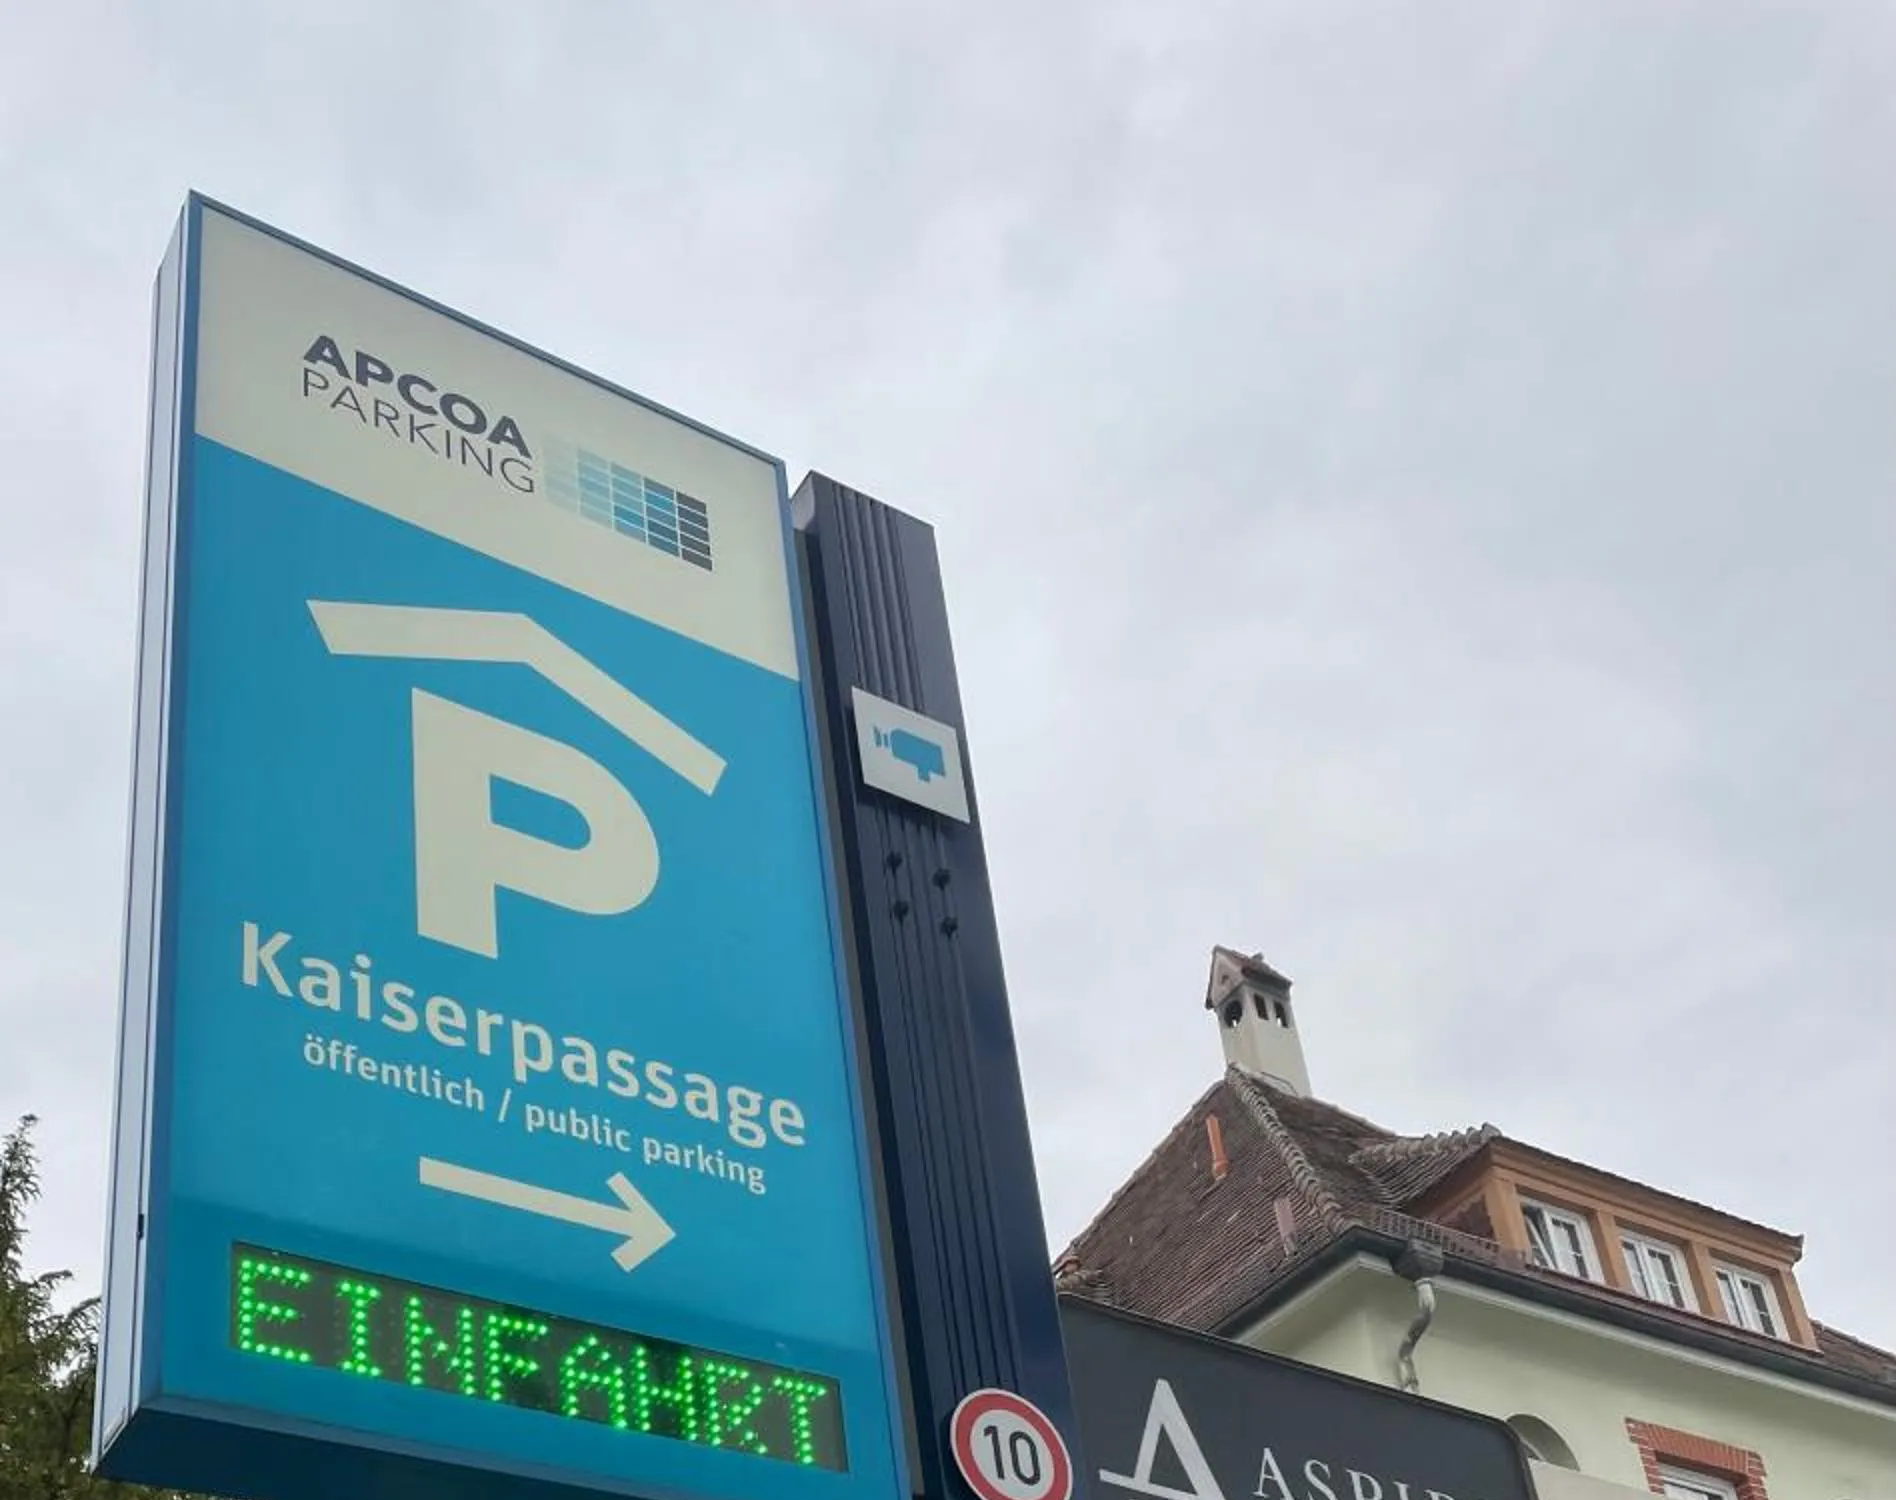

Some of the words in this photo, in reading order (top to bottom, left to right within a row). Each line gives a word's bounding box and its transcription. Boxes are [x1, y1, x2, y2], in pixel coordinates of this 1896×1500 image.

[303, 335, 532, 459] APCOA
[303, 368, 534, 494] PARKING
[411, 687, 660, 960] P
[241, 920, 806, 1149] Kaiserpassage
[303, 1033, 485, 1112] öffentlich
[498, 1087, 512, 1122] /
[525, 1100, 632, 1154] public
[643, 1134, 767, 1196] parking
[236, 1256, 828, 1467] EINFAHRT
[983, 1422, 1041, 1488] 10
